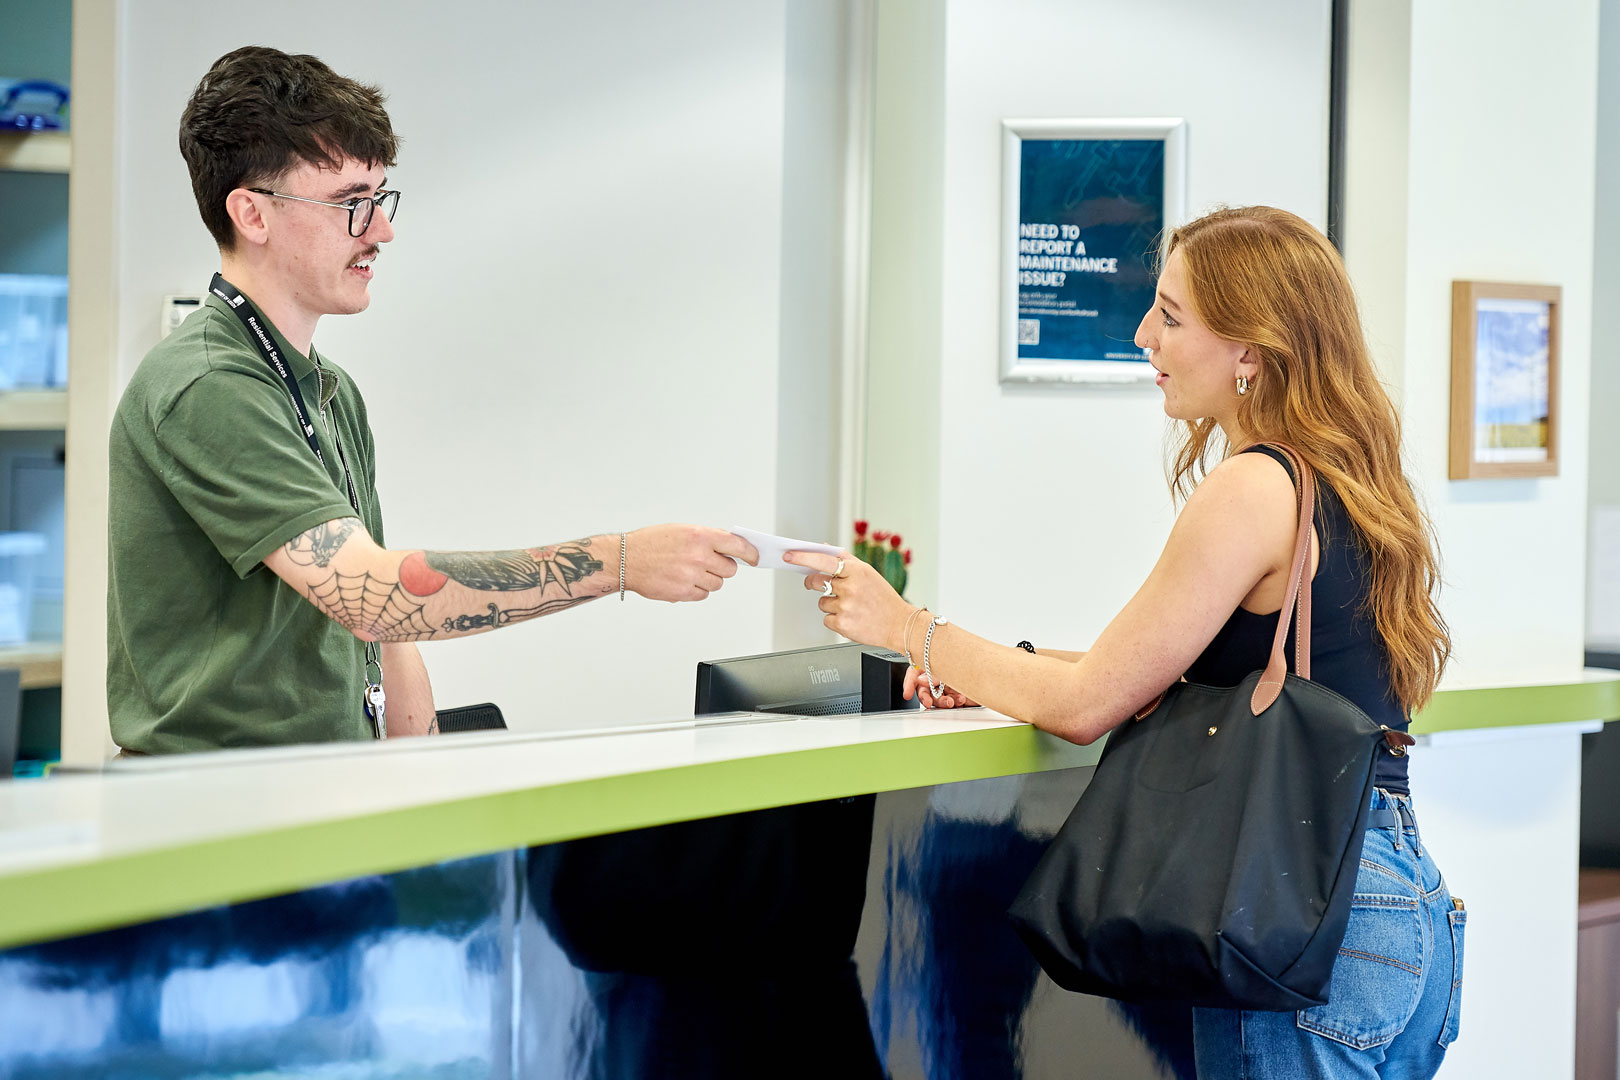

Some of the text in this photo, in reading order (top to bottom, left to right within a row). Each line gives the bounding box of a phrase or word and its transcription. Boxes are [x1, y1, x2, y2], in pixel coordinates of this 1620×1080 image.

[1020, 223, 1080, 240] NEED TO
[1019, 239, 1086, 256] REPORT A
[1019, 255, 1118, 273] MAINTENANCE
[1019, 271, 1066, 287] ISSUE?
[247, 316, 288, 379] Residential Services
[808, 665, 840, 685] iiyama
